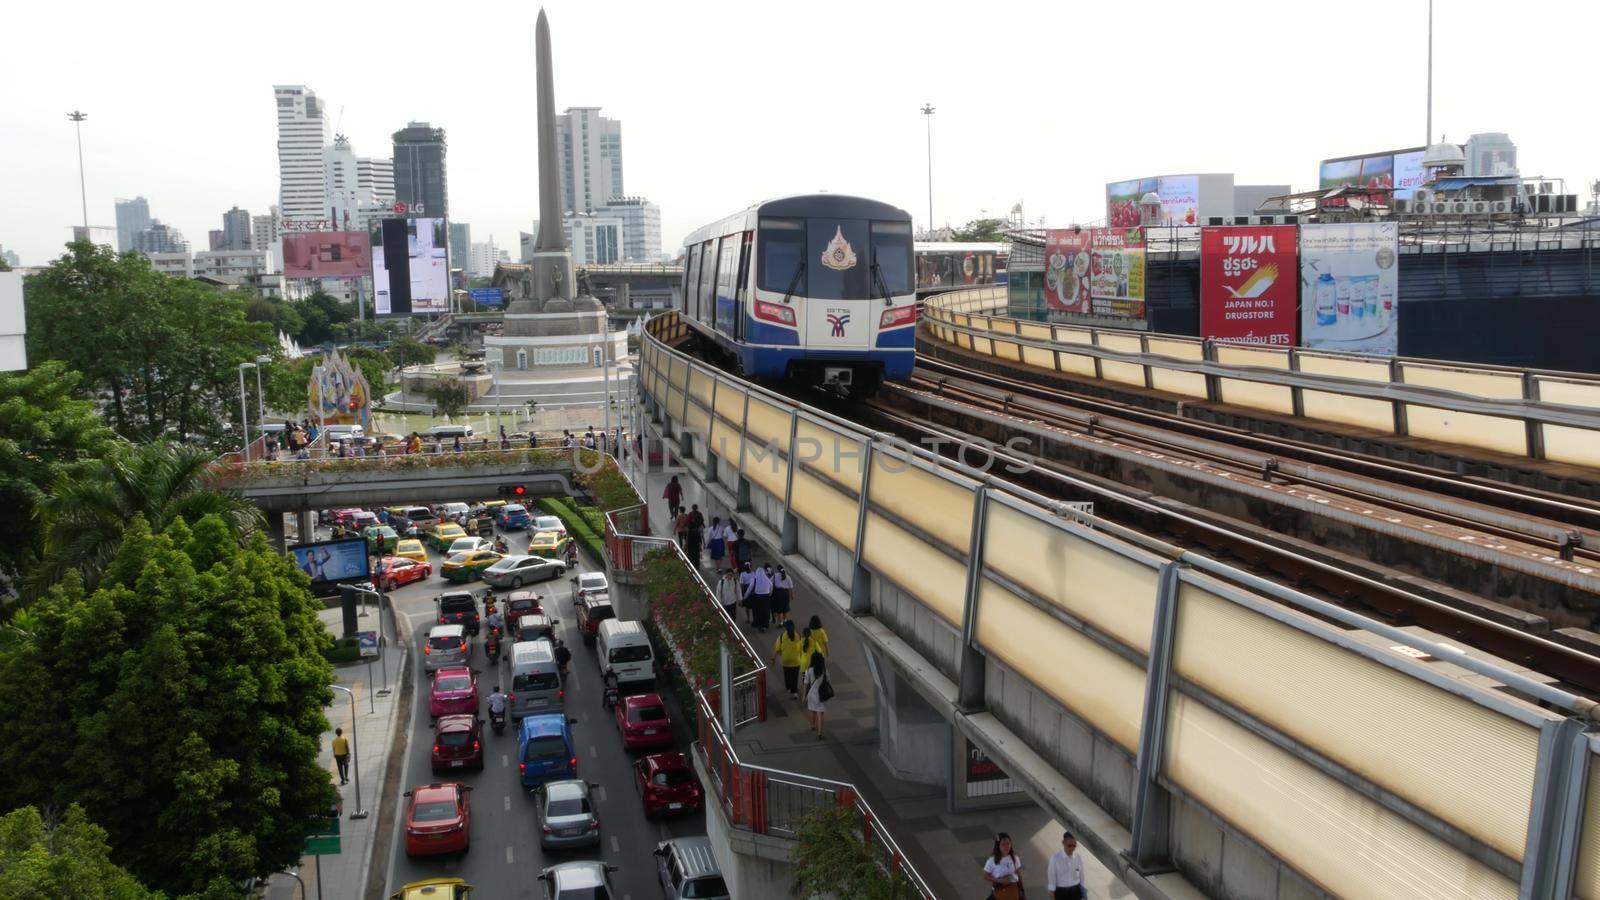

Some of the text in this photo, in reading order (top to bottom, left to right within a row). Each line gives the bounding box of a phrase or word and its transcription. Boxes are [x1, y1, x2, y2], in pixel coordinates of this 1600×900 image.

[408, 204, 425, 213] LG
[1223, 235, 1276, 254] ツルハ
[1225, 300, 1252, 308] JAPAN
[1225, 311, 1275, 320] DRUGSTORE
[1269, 334, 1290, 344] BTS
